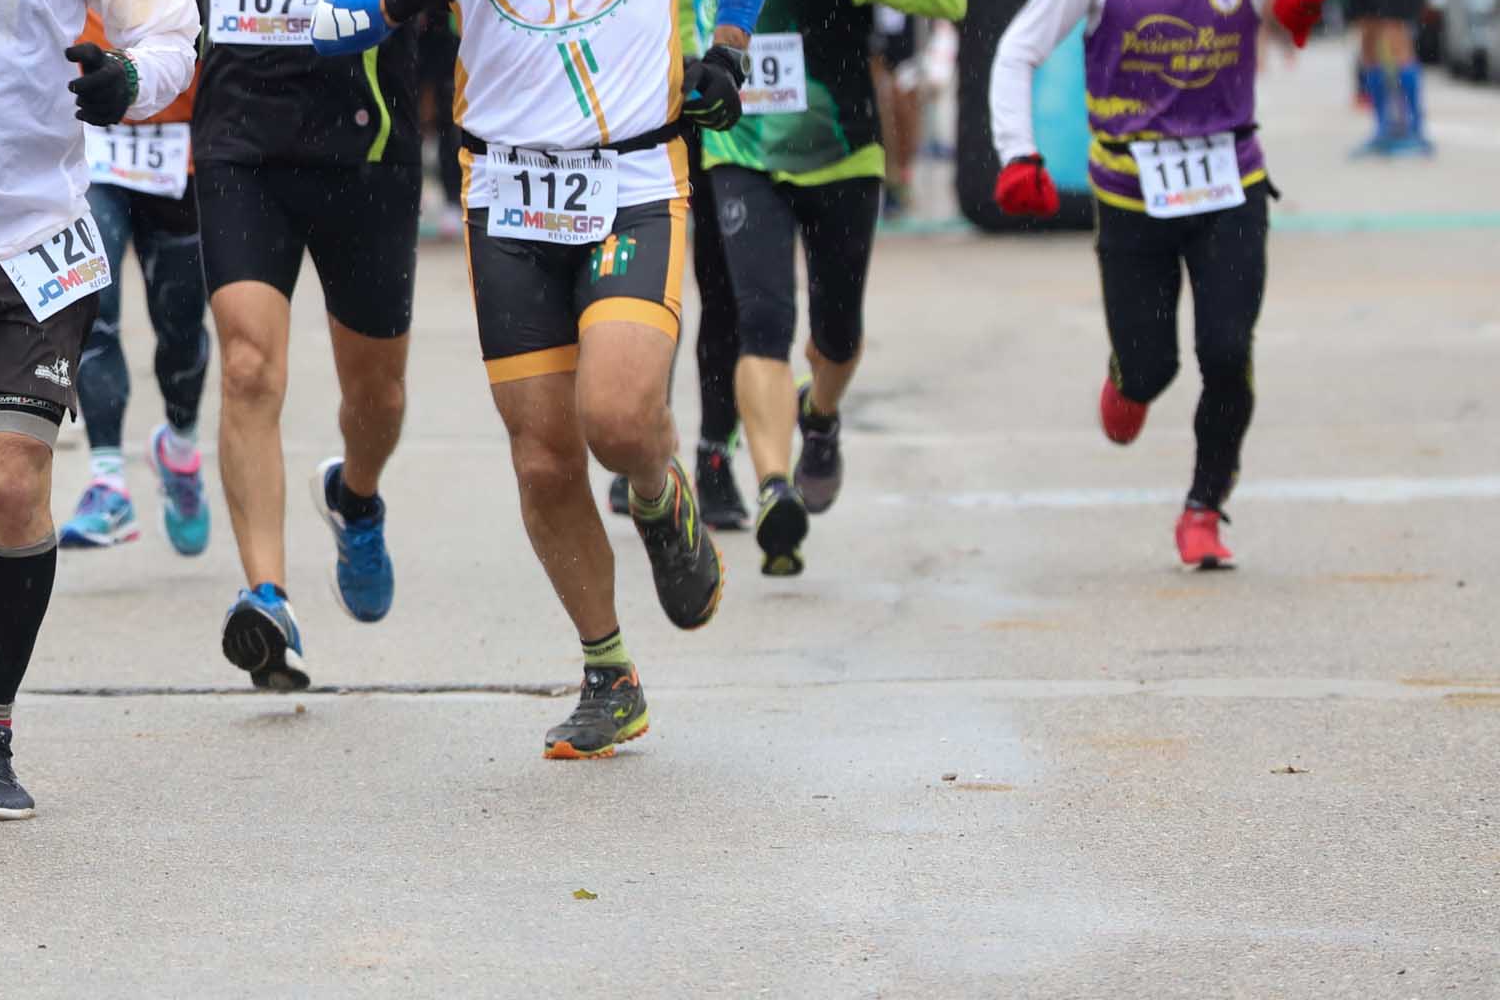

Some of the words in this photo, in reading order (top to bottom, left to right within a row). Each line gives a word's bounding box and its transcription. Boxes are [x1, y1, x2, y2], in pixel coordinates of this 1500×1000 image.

[106, 141, 164, 169] 115
[1156, 155, 1211, 190] 111
[513, 170, 588, 211] 112
[28, 217, 96, 274] 120
